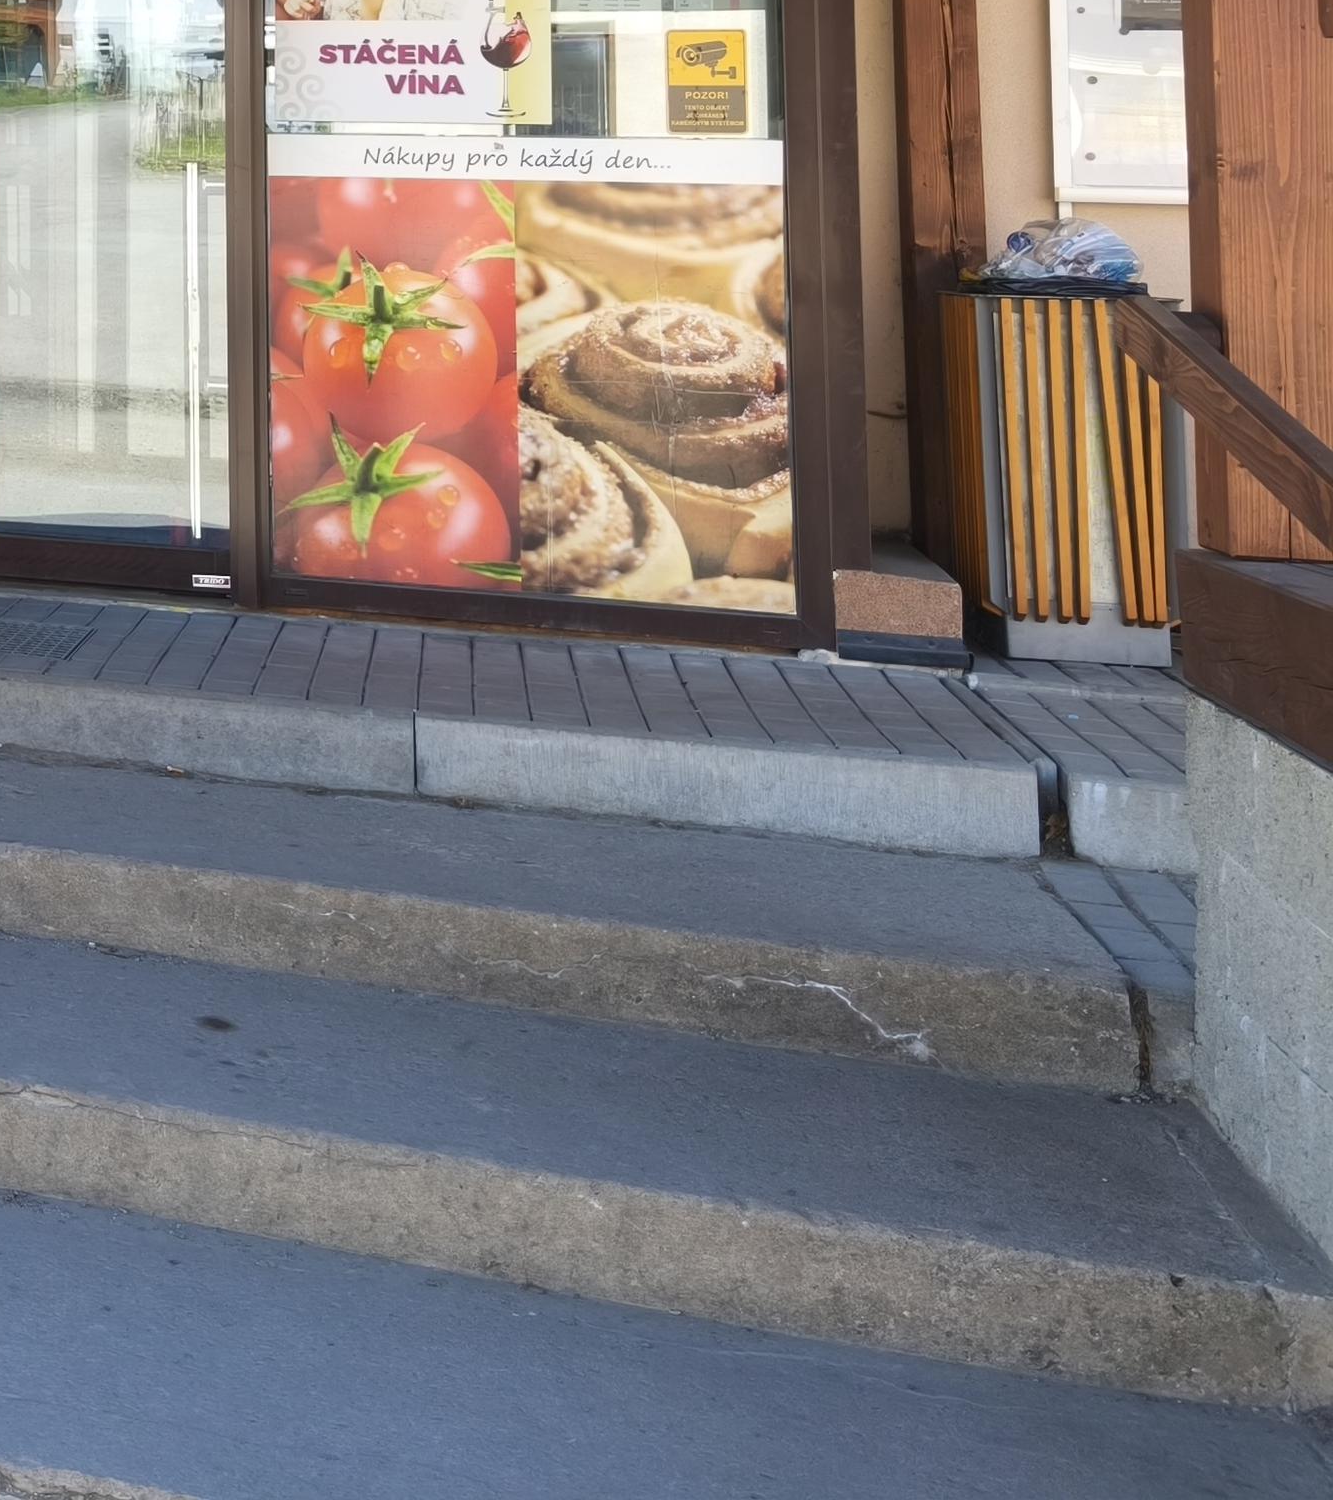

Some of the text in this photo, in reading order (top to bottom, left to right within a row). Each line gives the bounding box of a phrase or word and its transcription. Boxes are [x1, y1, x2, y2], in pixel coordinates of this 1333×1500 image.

[318, 38, 465, 66] STÁČENÁ
[385, 69, 466, 96] VÍNA
[363, 145, 673, 174] Nákupy pro každý den...
